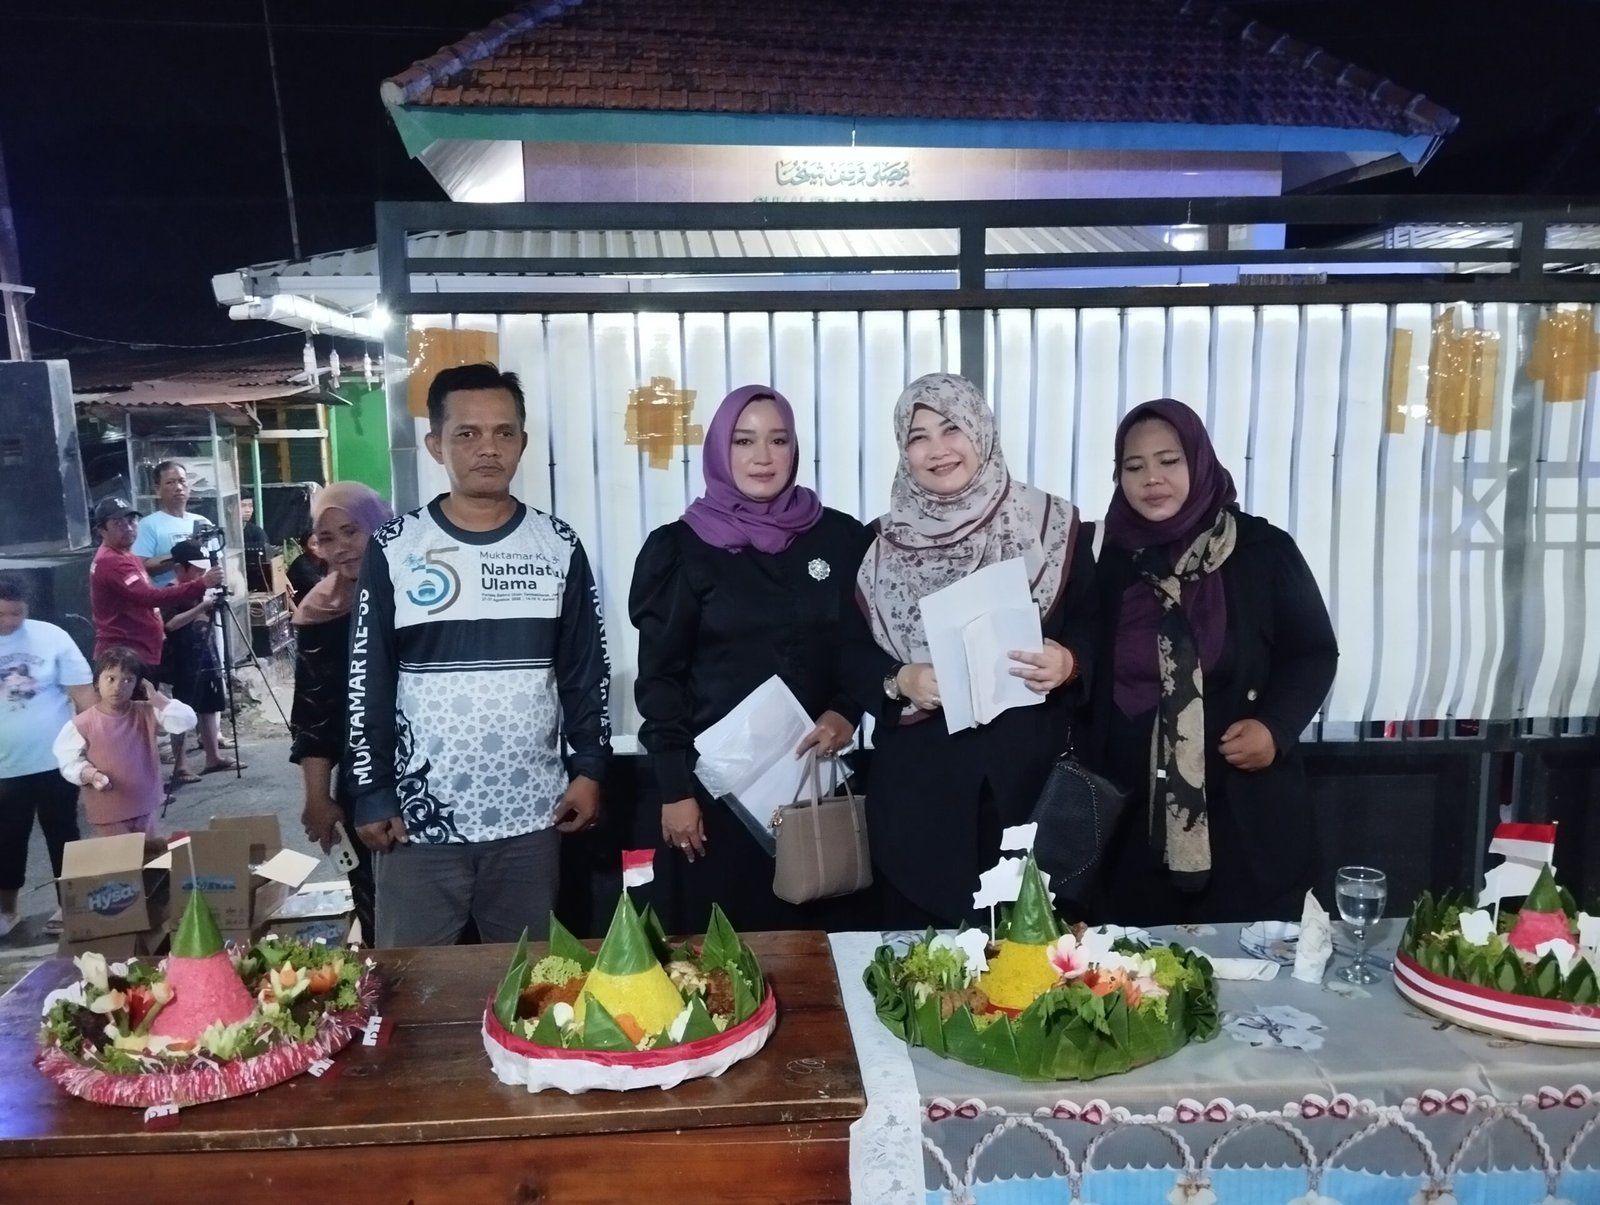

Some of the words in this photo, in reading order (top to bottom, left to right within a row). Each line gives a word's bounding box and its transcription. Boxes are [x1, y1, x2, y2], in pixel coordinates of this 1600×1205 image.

[480, 552, 533, 560] Muktamar
[481, 578, 537, 591] Ulama
[348, 659, 374, 785] MUKTAMAR
